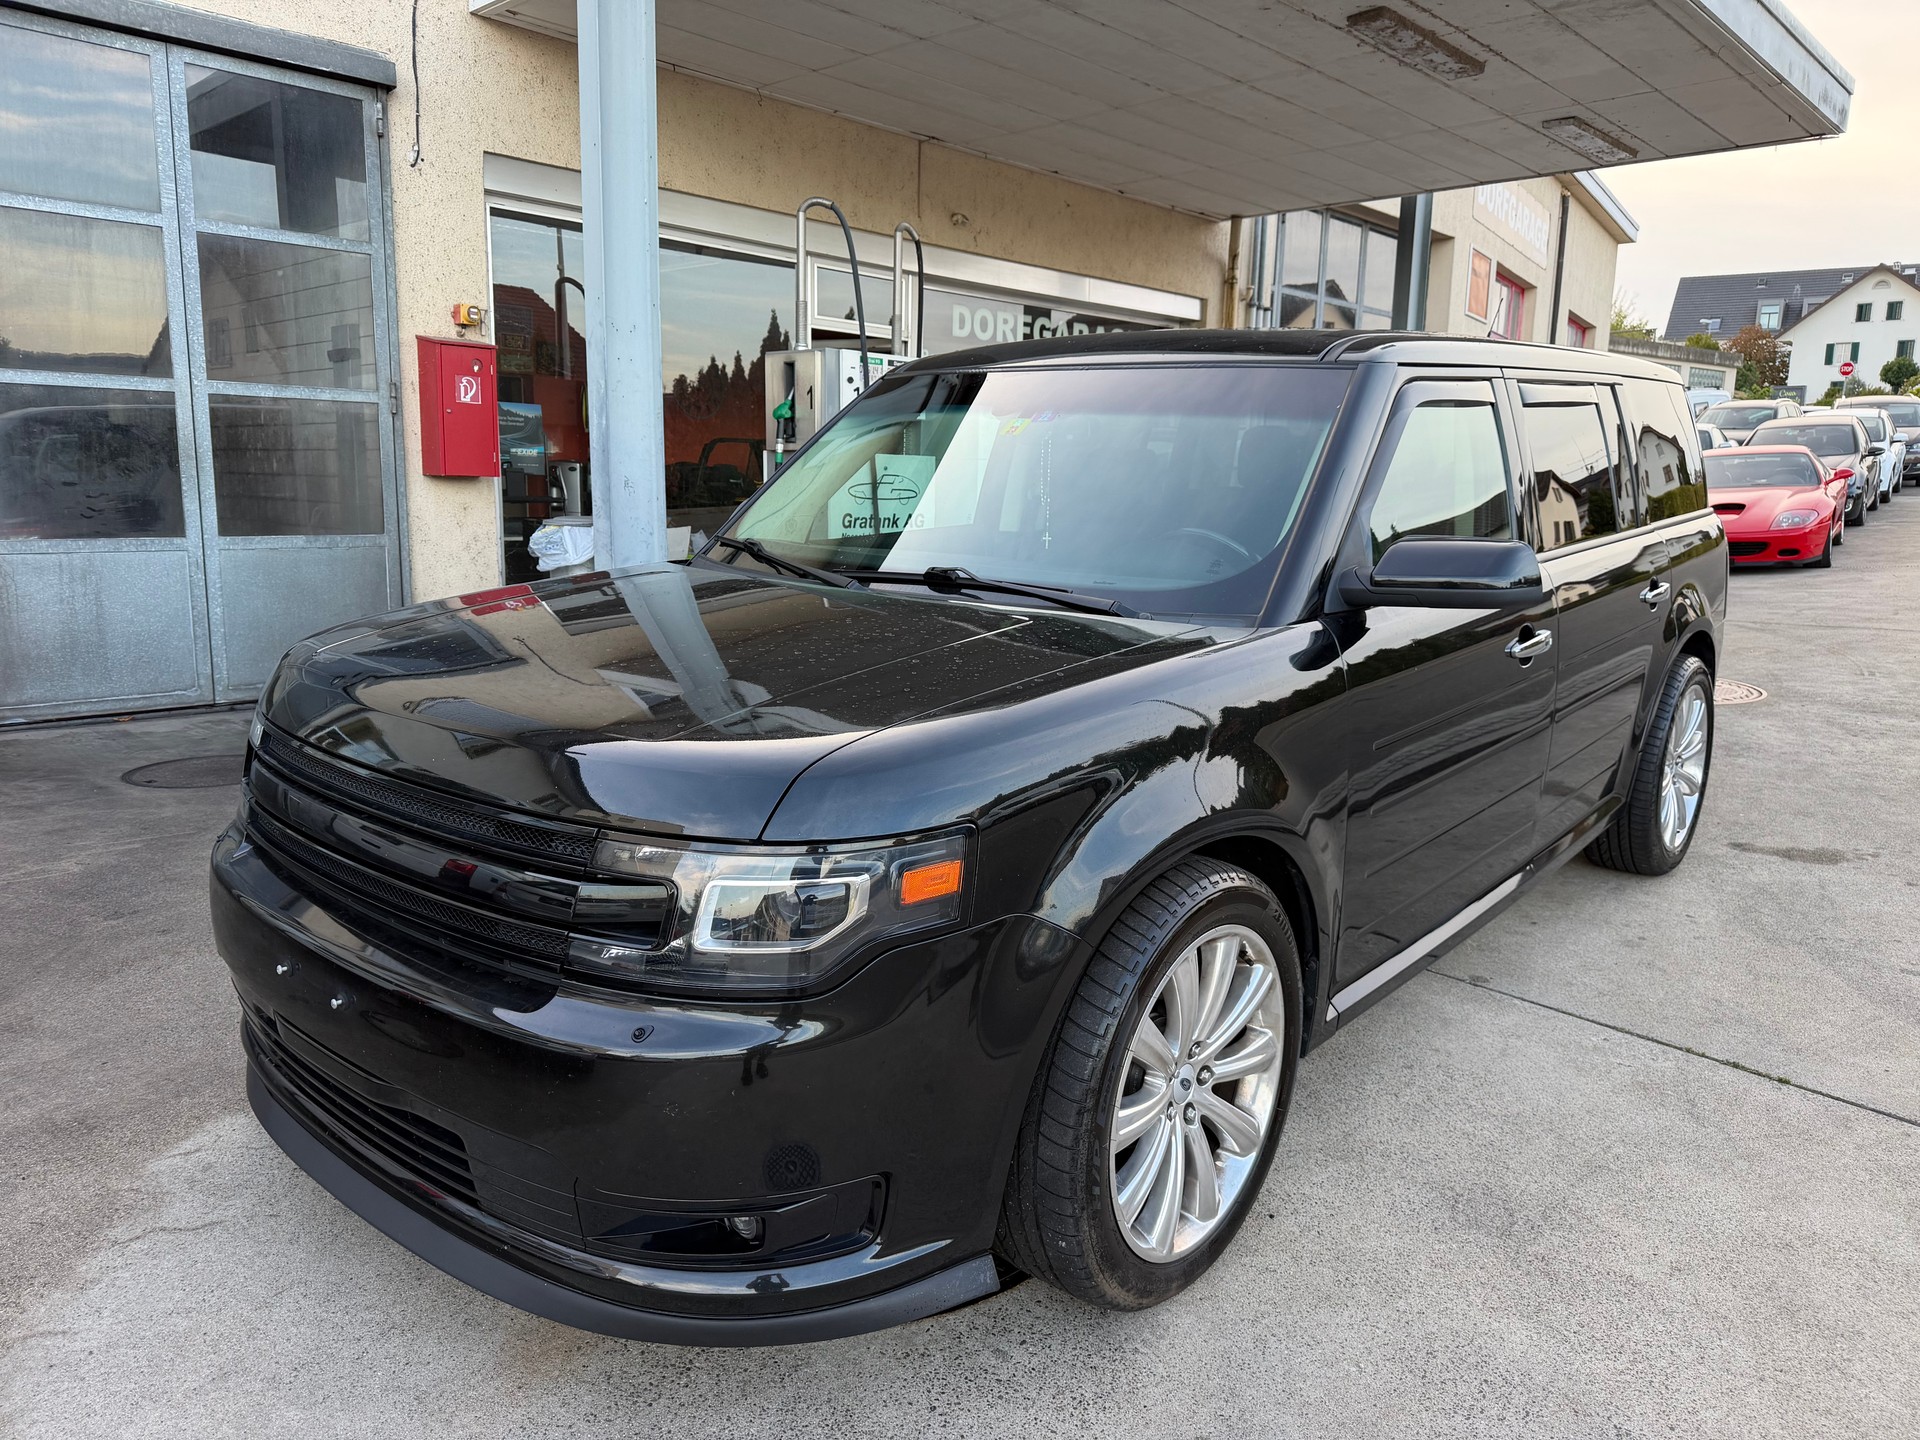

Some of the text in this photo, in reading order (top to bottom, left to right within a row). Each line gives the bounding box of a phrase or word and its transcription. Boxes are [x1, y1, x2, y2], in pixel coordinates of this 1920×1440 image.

[952, 303, 1126, 343] DORFGA
[807, 385, 813, 410] 1
[517, 448, 538, 457] EXIDE
[842, 513, 925, 528] Gratnk AG
